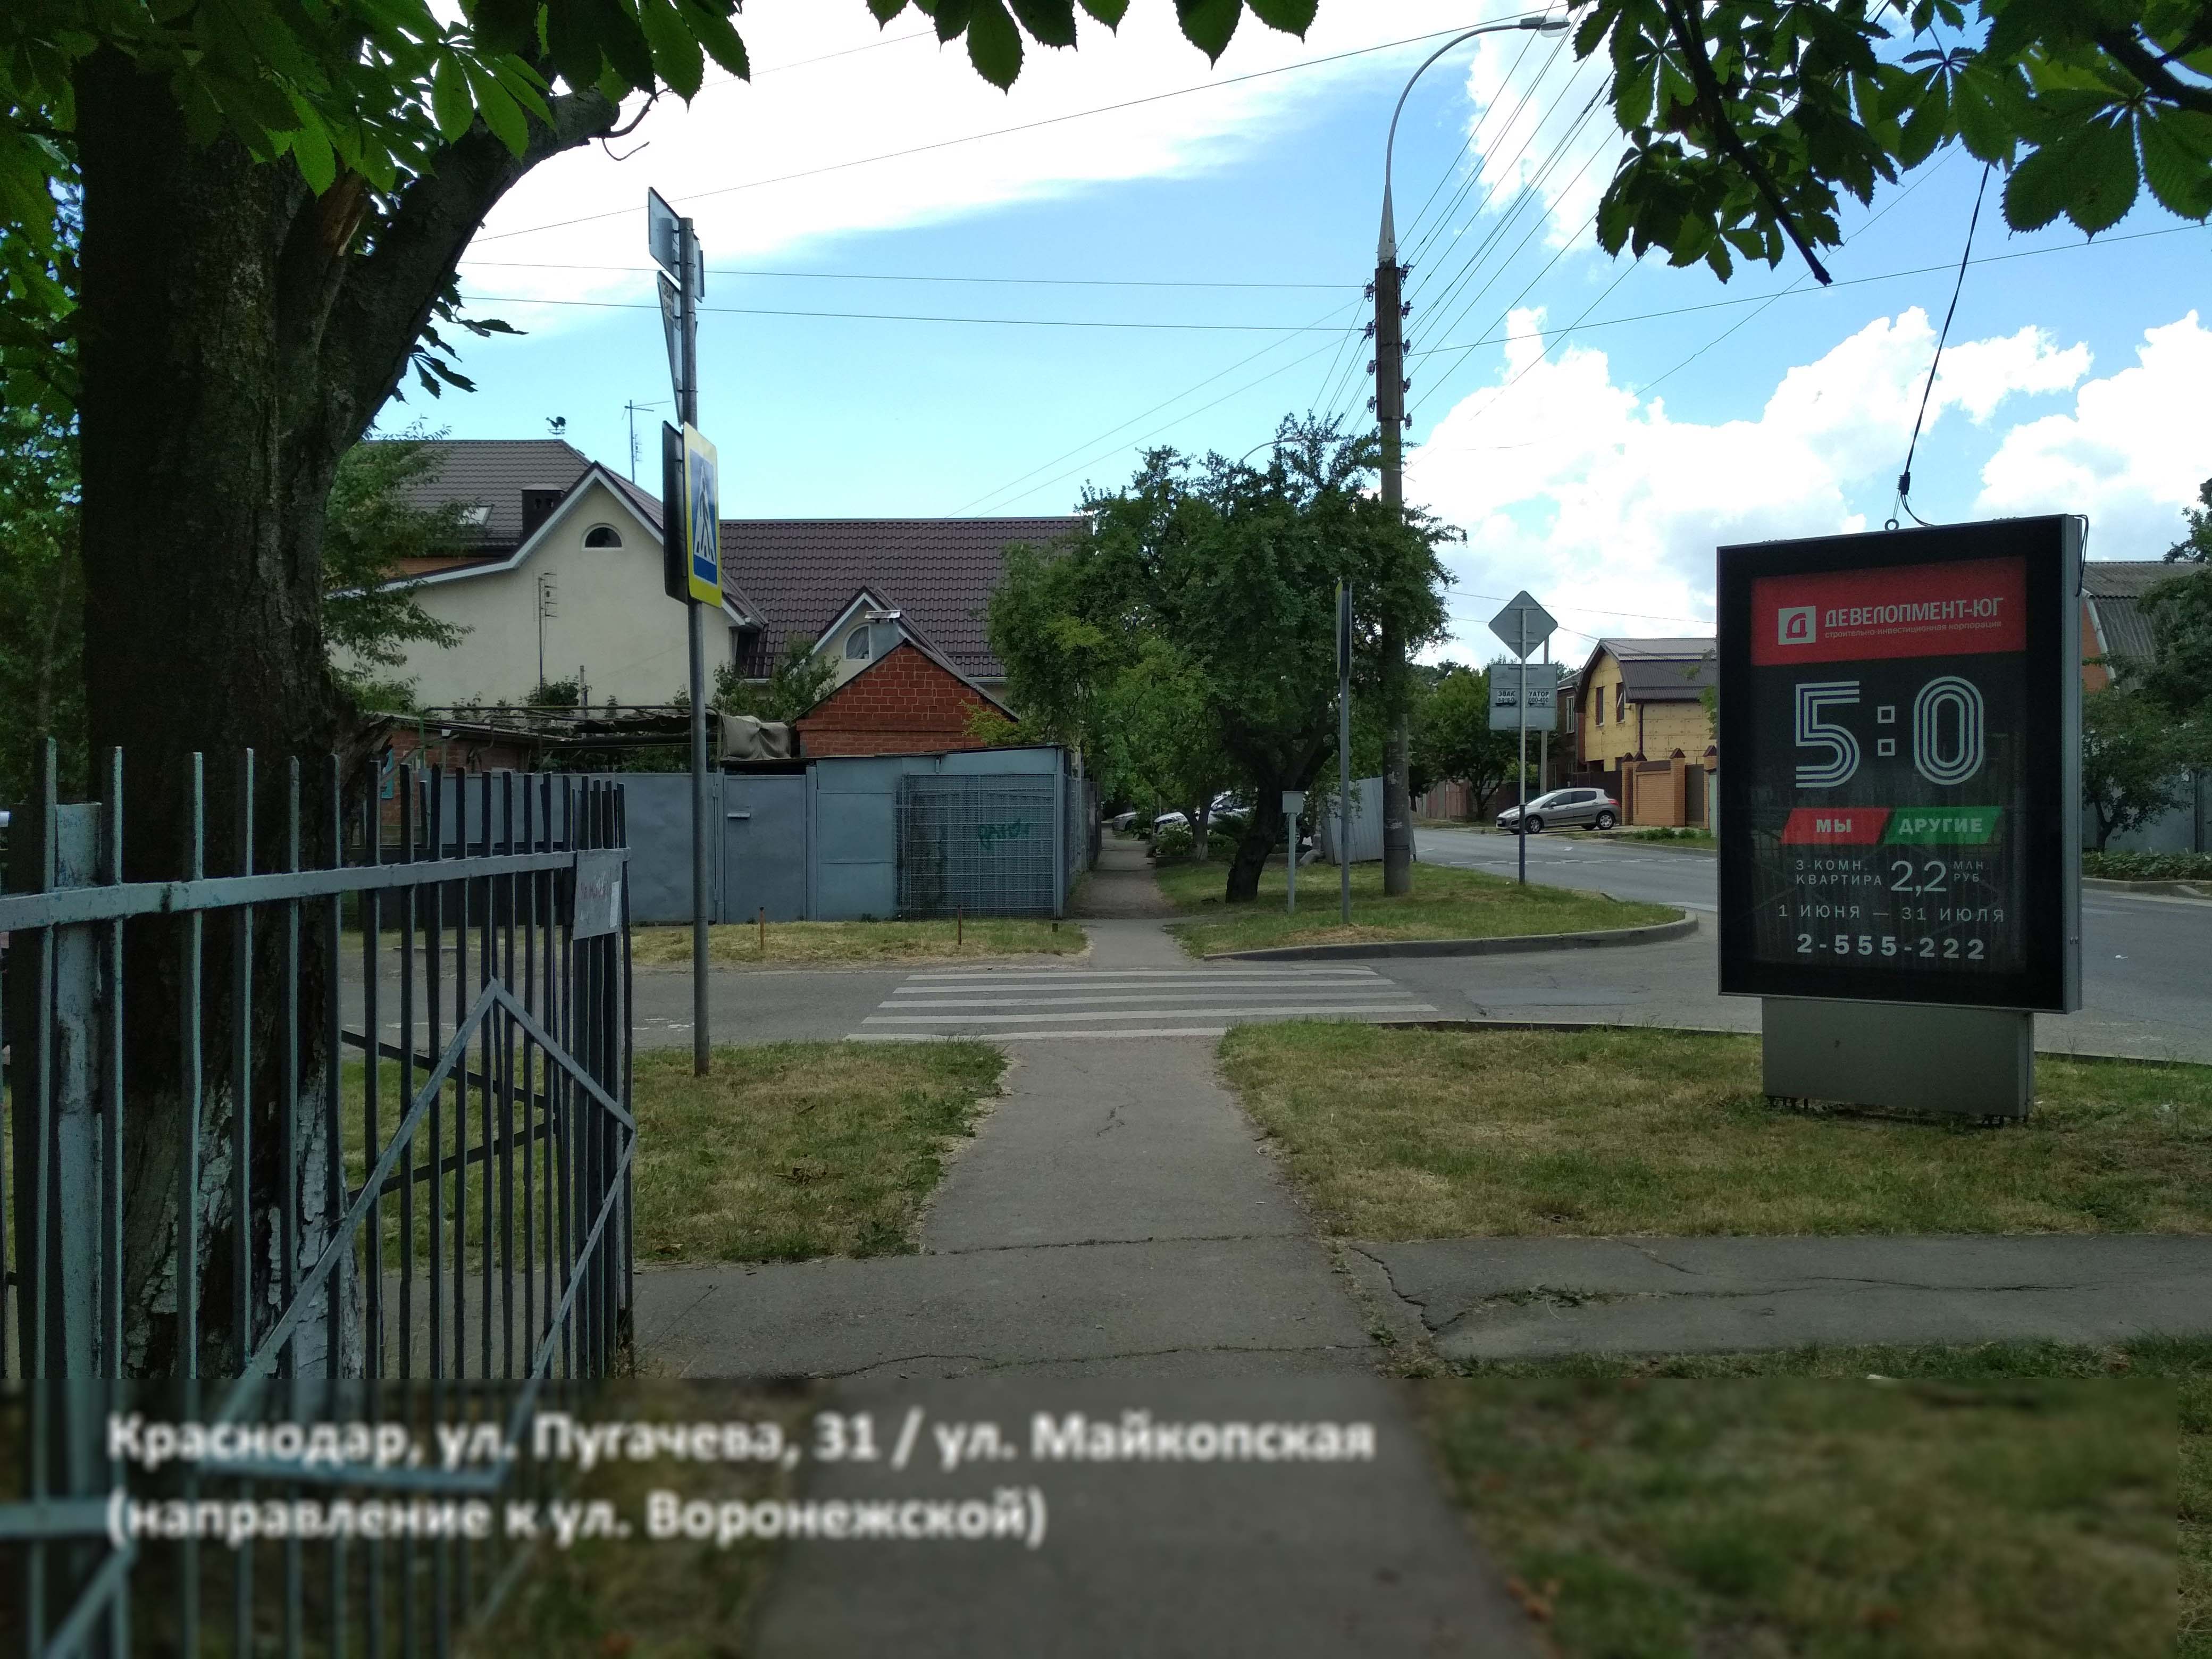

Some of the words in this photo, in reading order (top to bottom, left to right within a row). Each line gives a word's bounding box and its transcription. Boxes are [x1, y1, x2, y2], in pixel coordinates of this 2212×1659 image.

[1824, 597, 2004, 627] ДЕВЕЛОПМЕНТ-ЮГ
[1824, 623, 1947, 639] строительно-инвестиционная
[1948, 620, 2002, 632] корпорация
[1796, 676, 1984, 788] 5:0
[1815, 818, 1852, 834] МЫ
[1898, 818, 1983, 836] ДРУГИЕ
[1795, 874, 1882, 886] КВАРТИРА
[1890, 860, 1947, 897] 2,2
[1778, 905, 1788, 917] 1
[1800, 904, 1861, 919] ИЮНЯ
[1901, 907, 1928, 920] 31
[1939, 908, 2005, 923] ИЮЛЯ
[1797, 933, 1985, 960] 2-555-222
